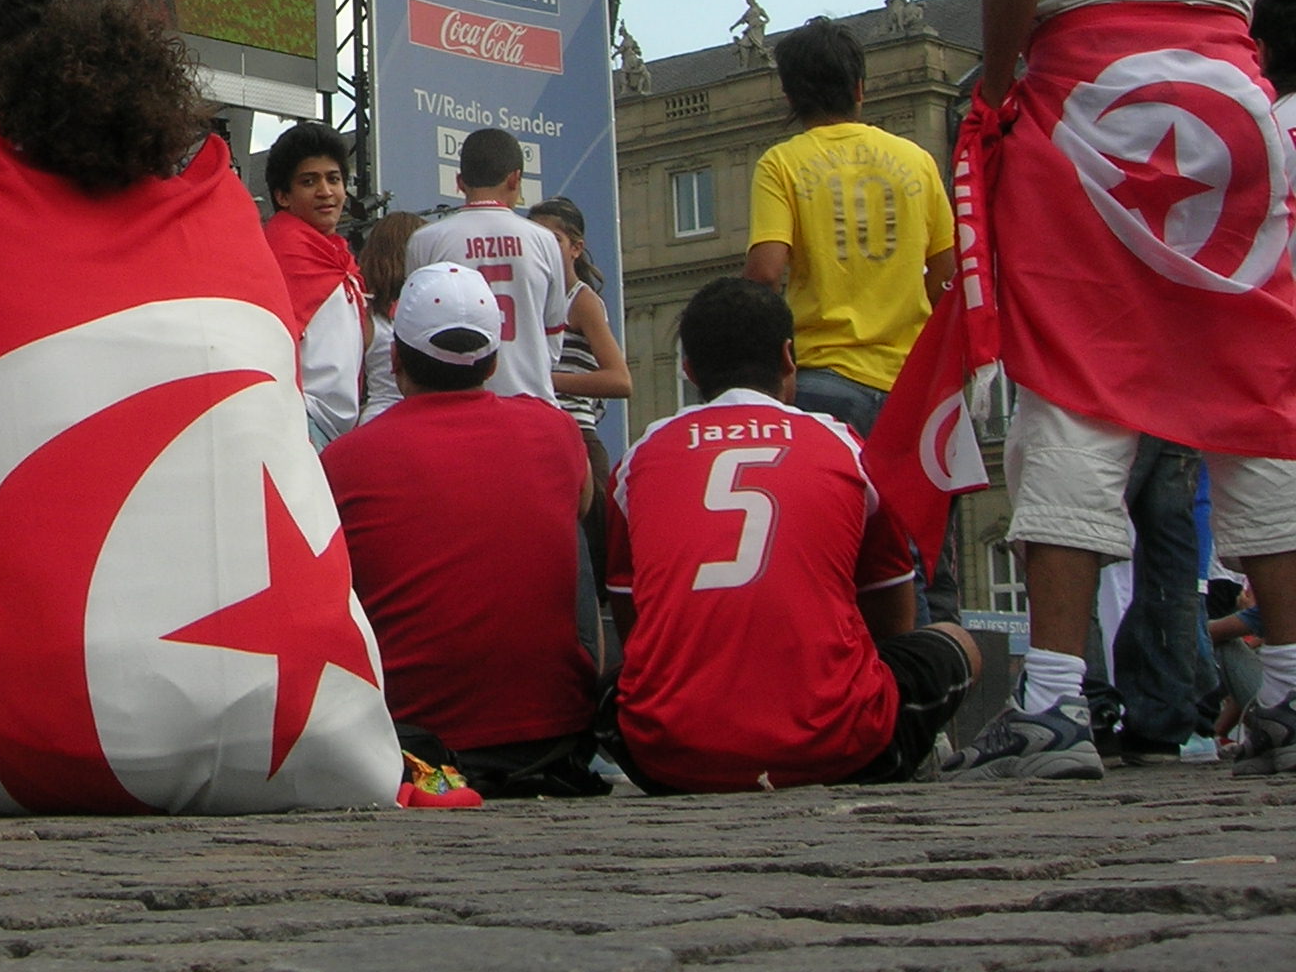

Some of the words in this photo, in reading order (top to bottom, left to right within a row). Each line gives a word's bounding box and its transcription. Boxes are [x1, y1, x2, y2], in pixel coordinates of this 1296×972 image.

[440, 11, 528, 65] Coca-Cola
[414, 88, 493, 126] TV/Radio
[499, 108, 564, 137] Sender
[828, 175, 897, 262] 10
[465, 236, 523, 259] JAZIRI
[688, 419, 793, 449] jaziri
[692, 445, 790, 591] 5
